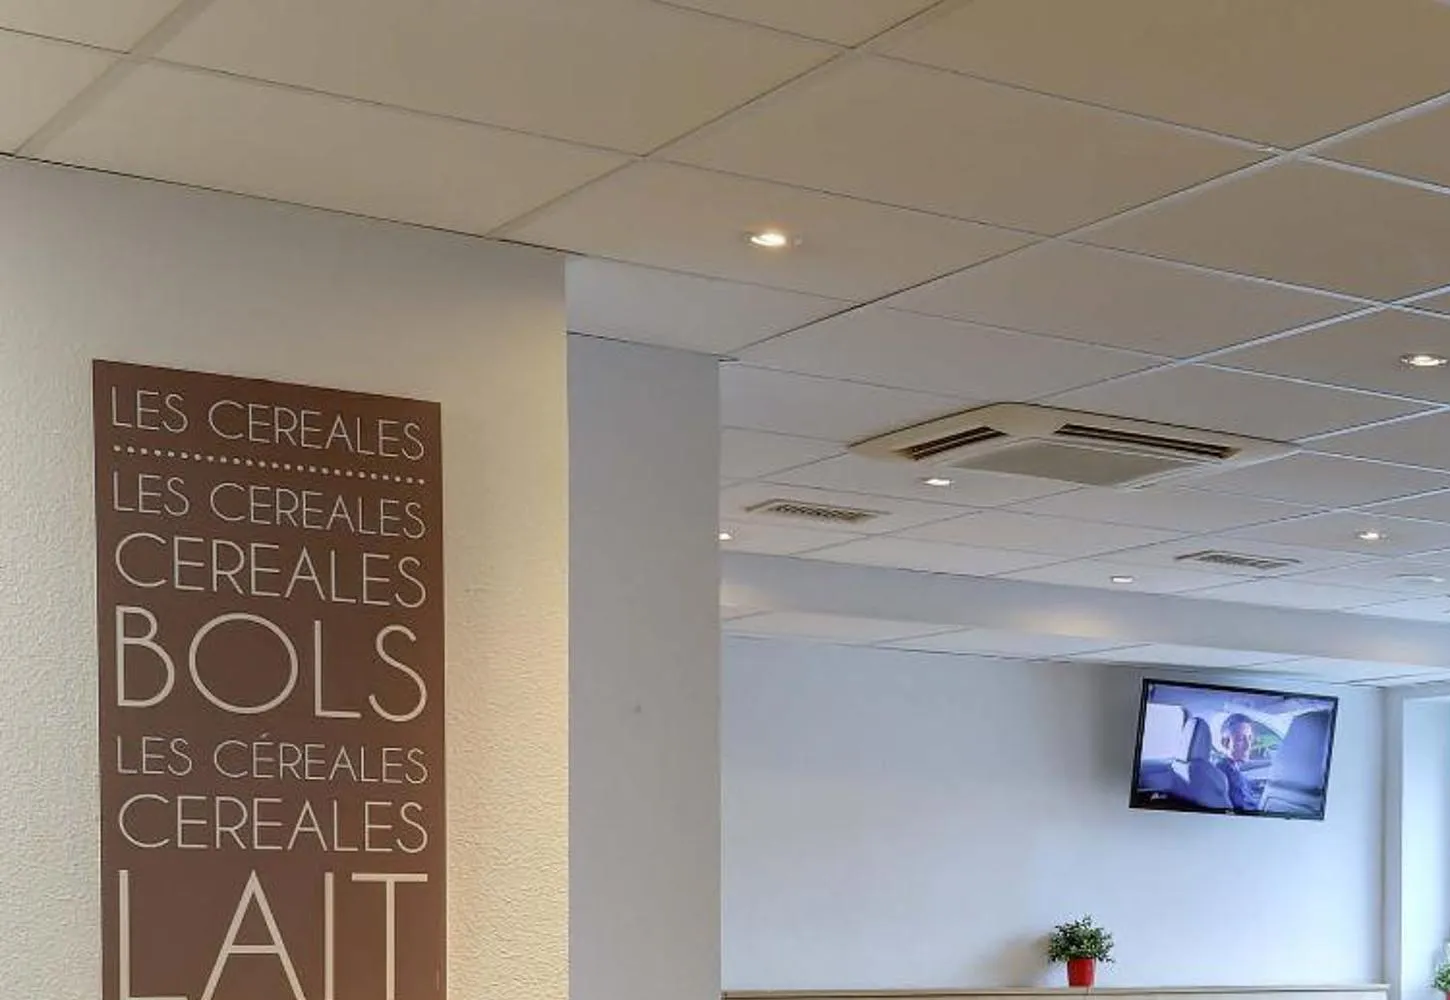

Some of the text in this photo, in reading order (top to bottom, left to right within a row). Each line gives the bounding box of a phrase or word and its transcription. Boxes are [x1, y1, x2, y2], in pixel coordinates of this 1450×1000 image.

[110, 385, 426, 461] LES CEREALES
[112, 471, 426, 539] LES CEREALES
[115, 532, 427, 609] CEREALES
[115, 605, 428, 721] BOLS
[116, 732, 428, 784] LES CÉREALES
[118, 793, 429, 853] CEREALES
